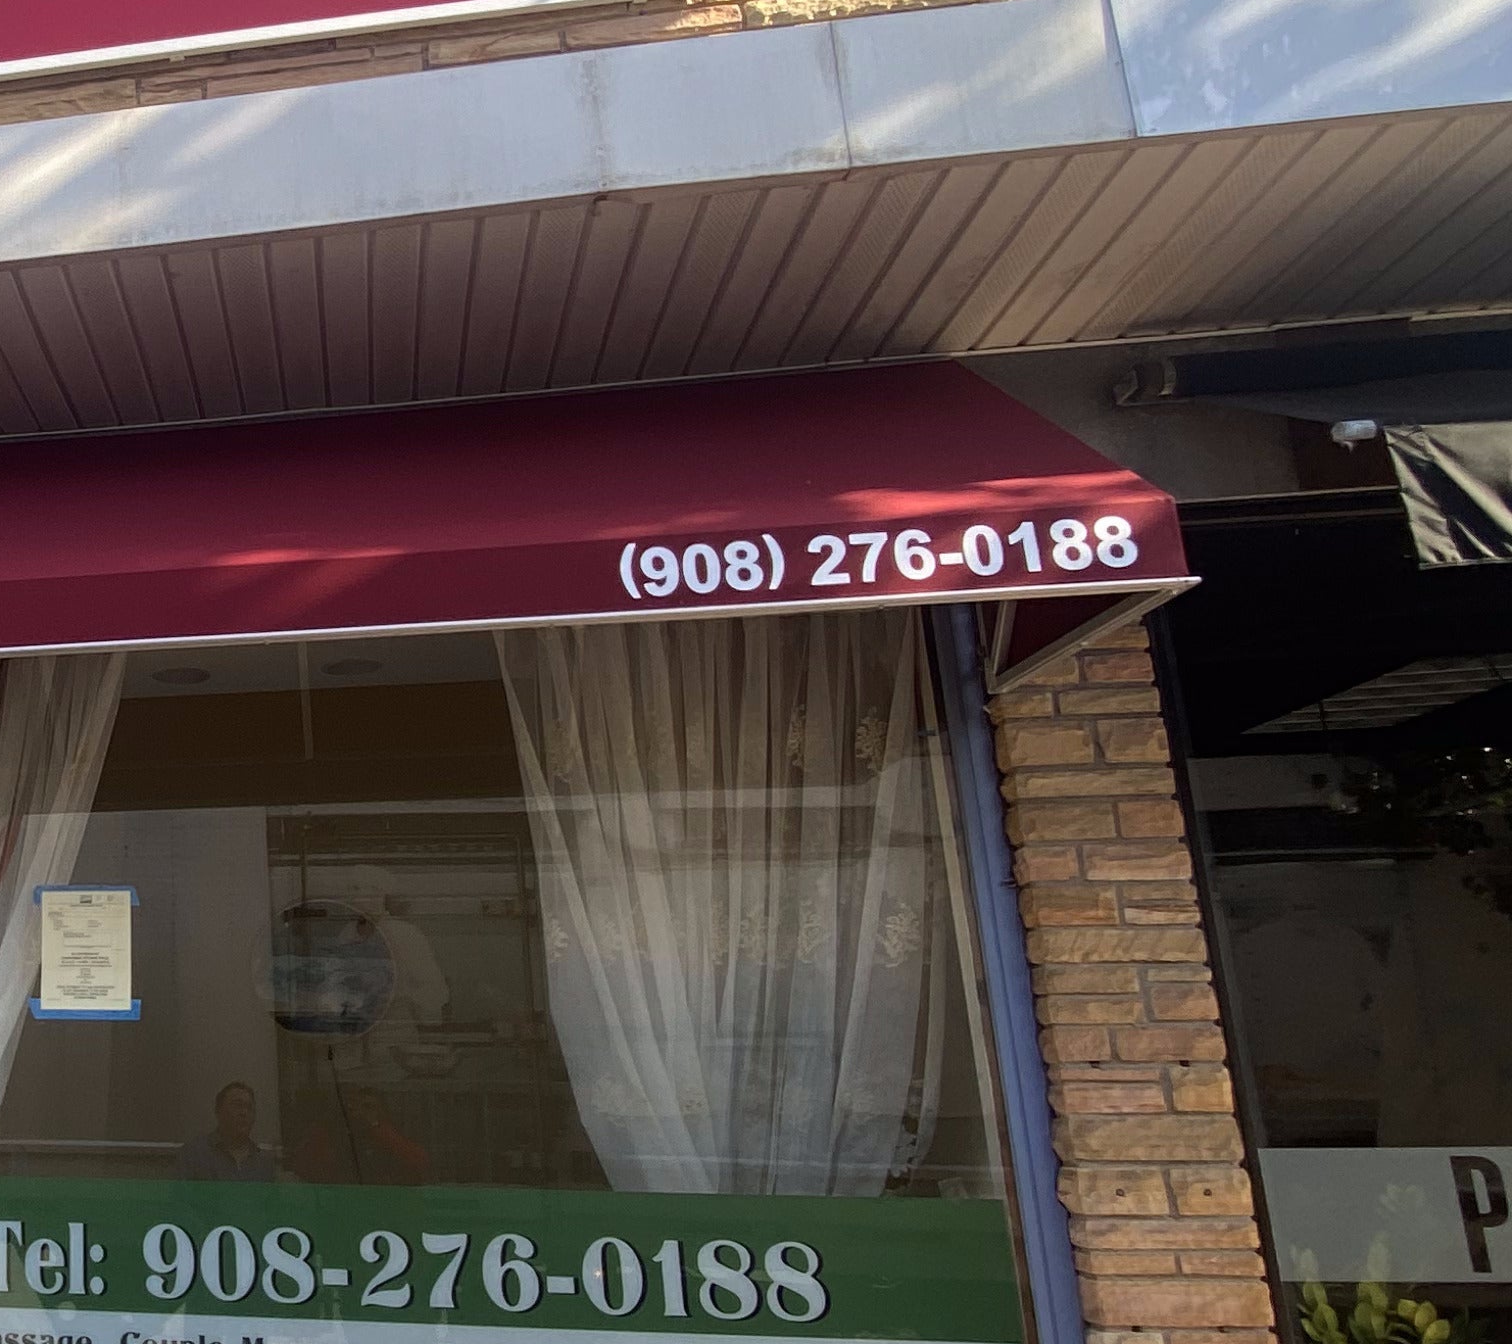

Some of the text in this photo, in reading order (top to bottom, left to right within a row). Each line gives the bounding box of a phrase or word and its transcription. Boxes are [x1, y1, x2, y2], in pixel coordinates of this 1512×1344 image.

[620, 516, 1138, 599] (908) 276-0188
[142, 1223, 829, 1323] 908-276-0188
